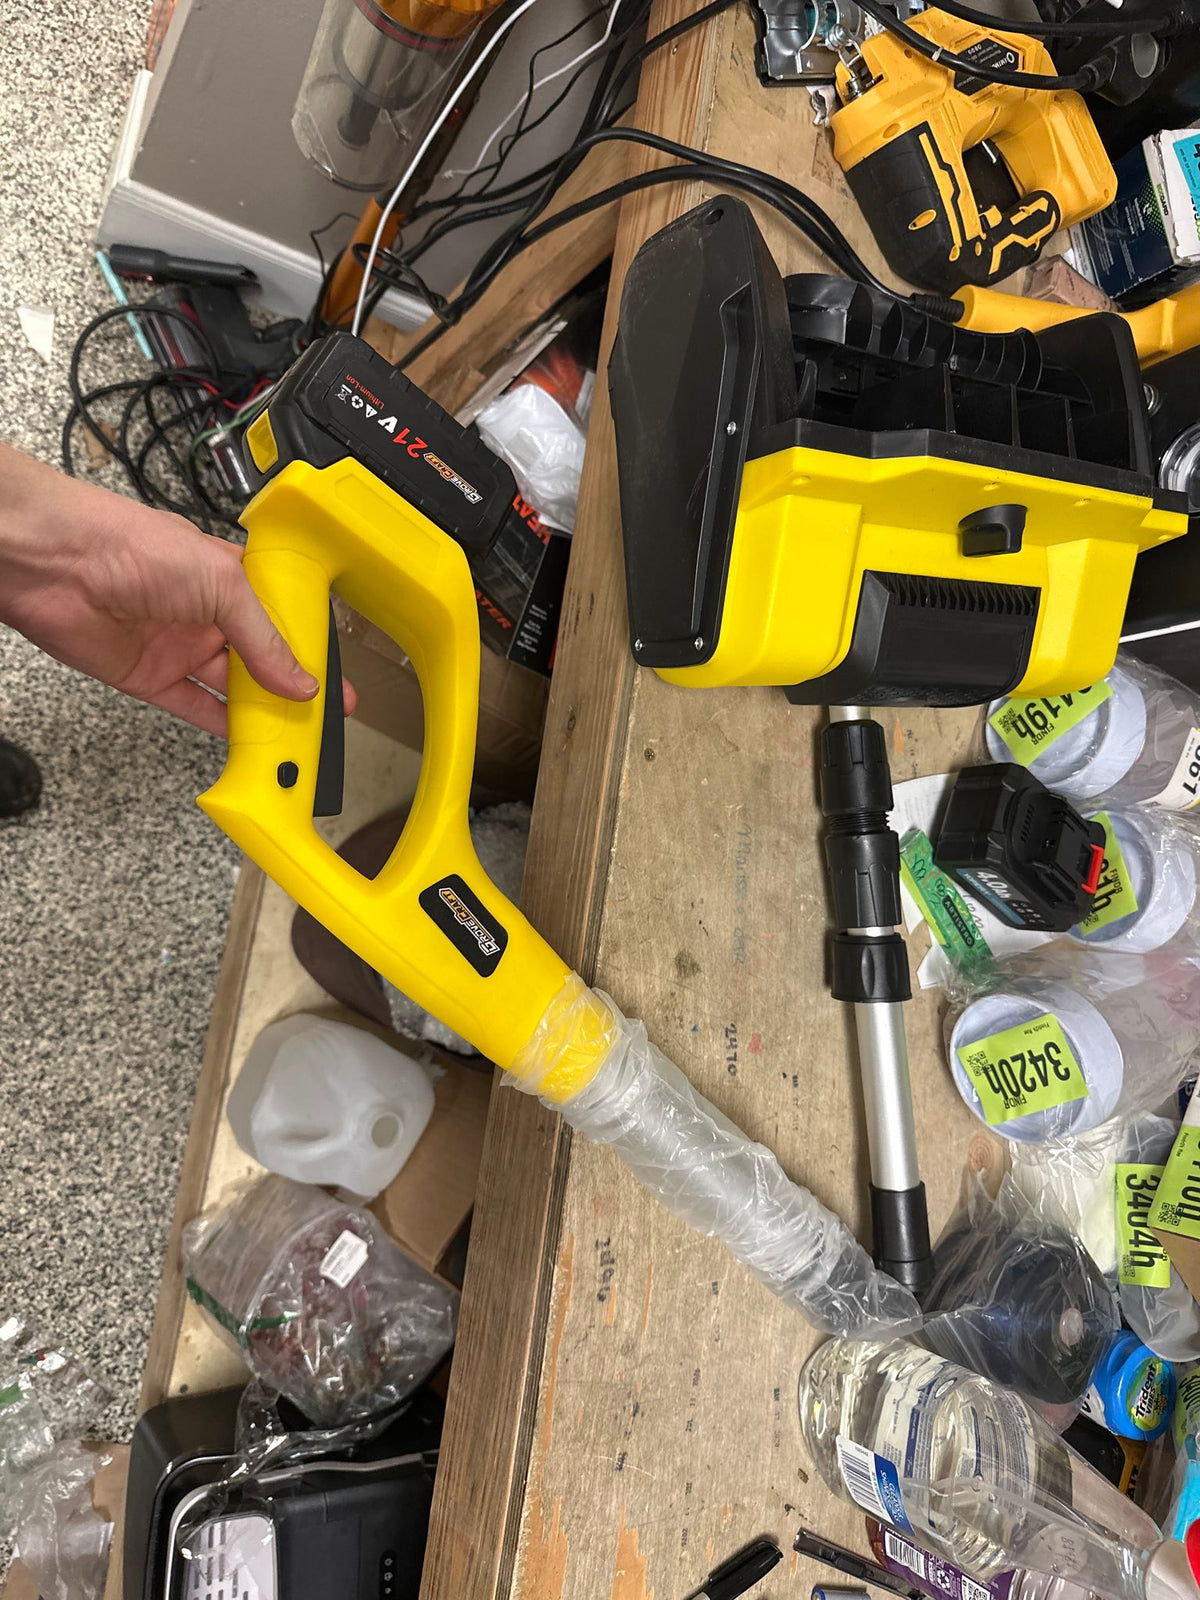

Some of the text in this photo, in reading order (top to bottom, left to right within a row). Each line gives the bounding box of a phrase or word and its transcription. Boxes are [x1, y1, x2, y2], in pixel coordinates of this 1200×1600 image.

[345, 374, 385, 409] Lithium-Lon
[944, 899, 974, 946] ARTISTRO
[983, 1042, 1071, 1100] 3420h
[1135, 1364, 1157, 1416] Trident
[1146, 1388, 1156, 1413] VIBES
